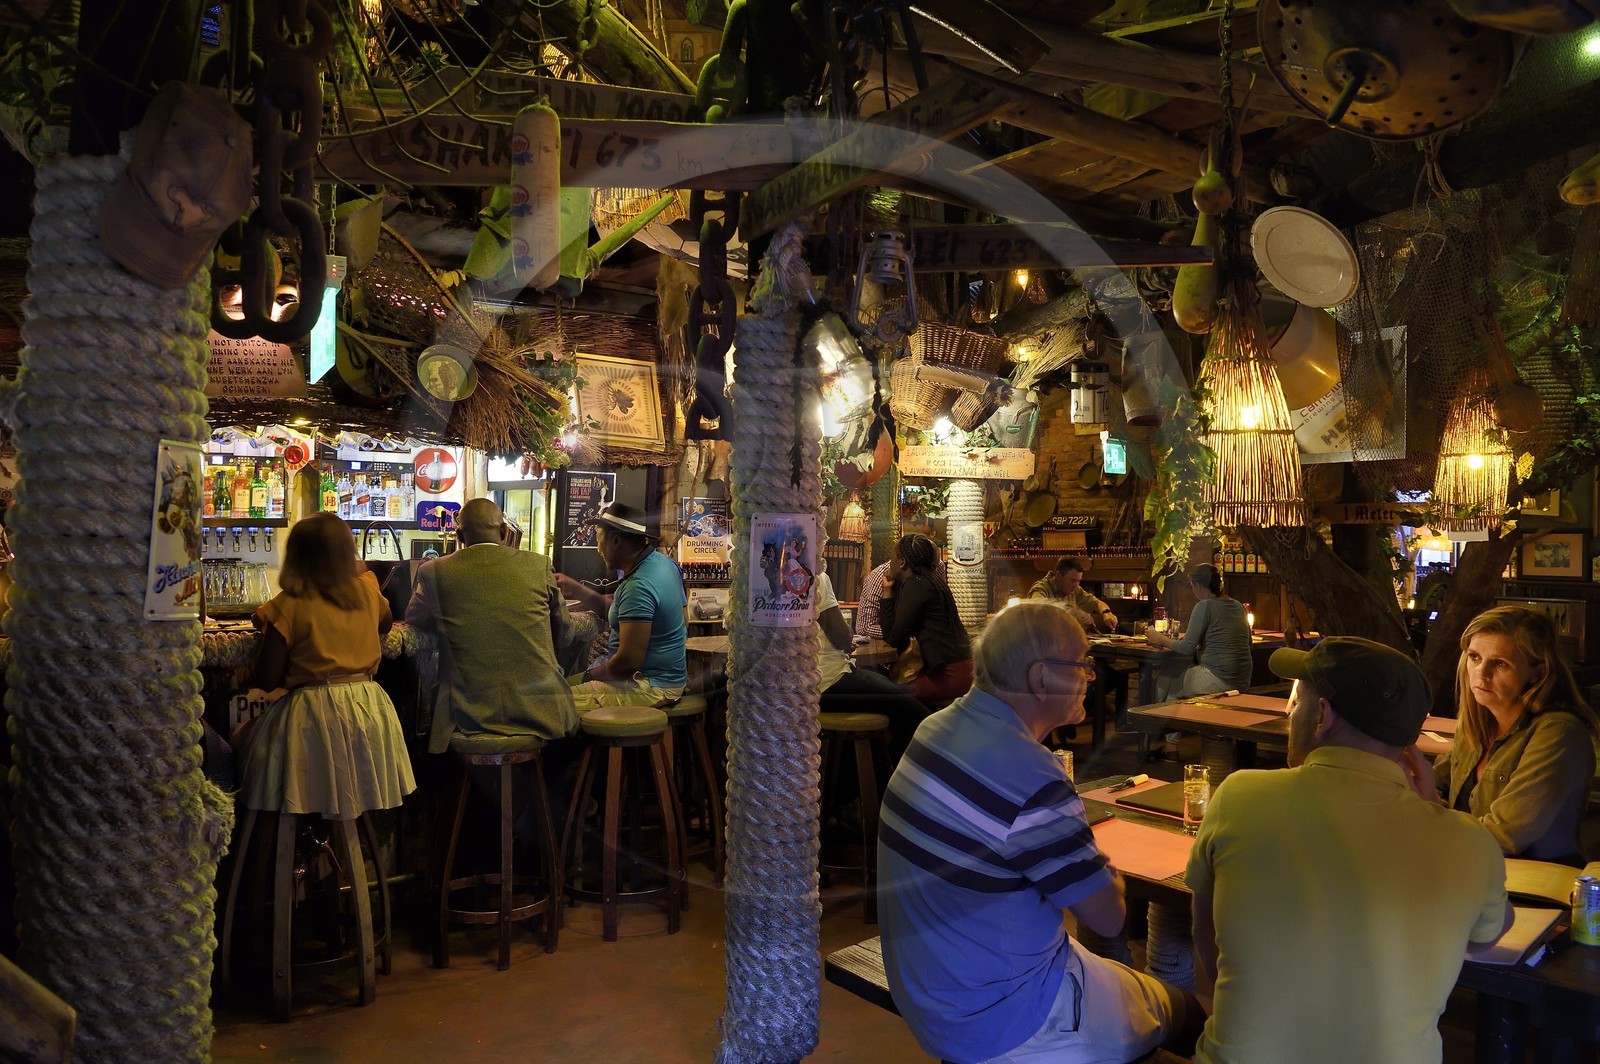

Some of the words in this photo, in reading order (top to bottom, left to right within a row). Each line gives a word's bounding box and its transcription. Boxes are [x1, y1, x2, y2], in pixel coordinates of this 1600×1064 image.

[595, 131, 663, 172] 673
[676, 147, 704, 175] km
[259, 349, 278, 357] LINE
[280, 358, 294, 367] NIE
[1304, 397, 1336, 423] brewing
[958, 467, 978, 476] SNAKE
[994, 469, 1011, 478] WELL
[570, 487, 580, 496] ON
[580, 487, 592, 496] TAP
[1355, 505, 1394, 522] Meter
[420, 517, 439, 528] Red
[752, 595, 791, 612] Pschorr
[789, 597, 810, 611] Bräu
[237, 696, 270, 722] Pri
